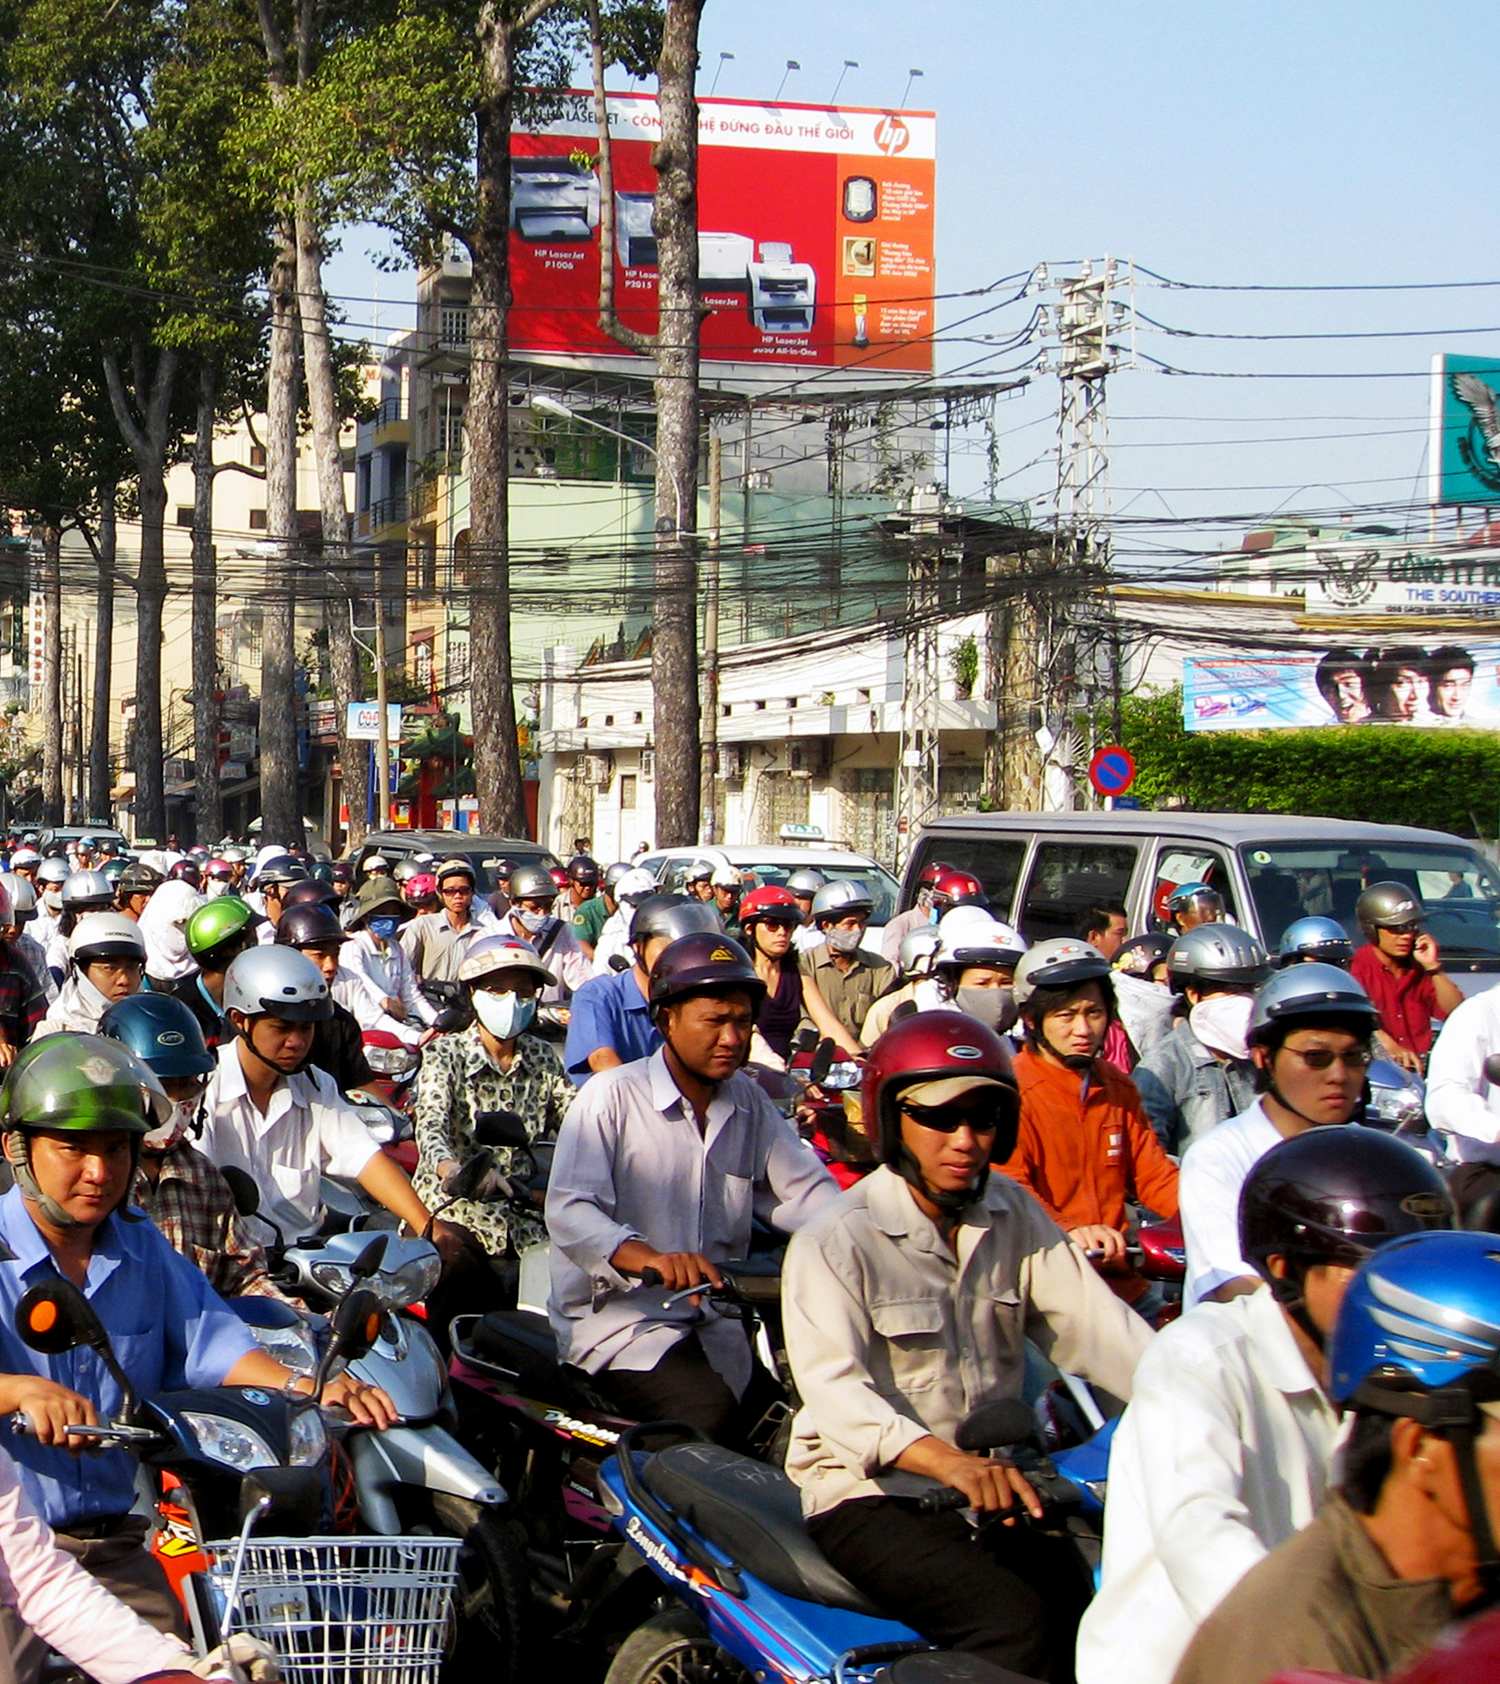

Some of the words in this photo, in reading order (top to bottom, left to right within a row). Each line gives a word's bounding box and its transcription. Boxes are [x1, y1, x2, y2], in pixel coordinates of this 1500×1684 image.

[566, 112, 619, 125] LASEET
[874, 114, 910, 157] hp
[534, 249, 547, 257] HP
[549, 250, 585, 259] LaserJet
[625, 281, 652, 289] P2015
[761, 335, 774, 343] HP
[1405, 588, 1435, 602] THE
[786, 824, 821, 835] TAXI
